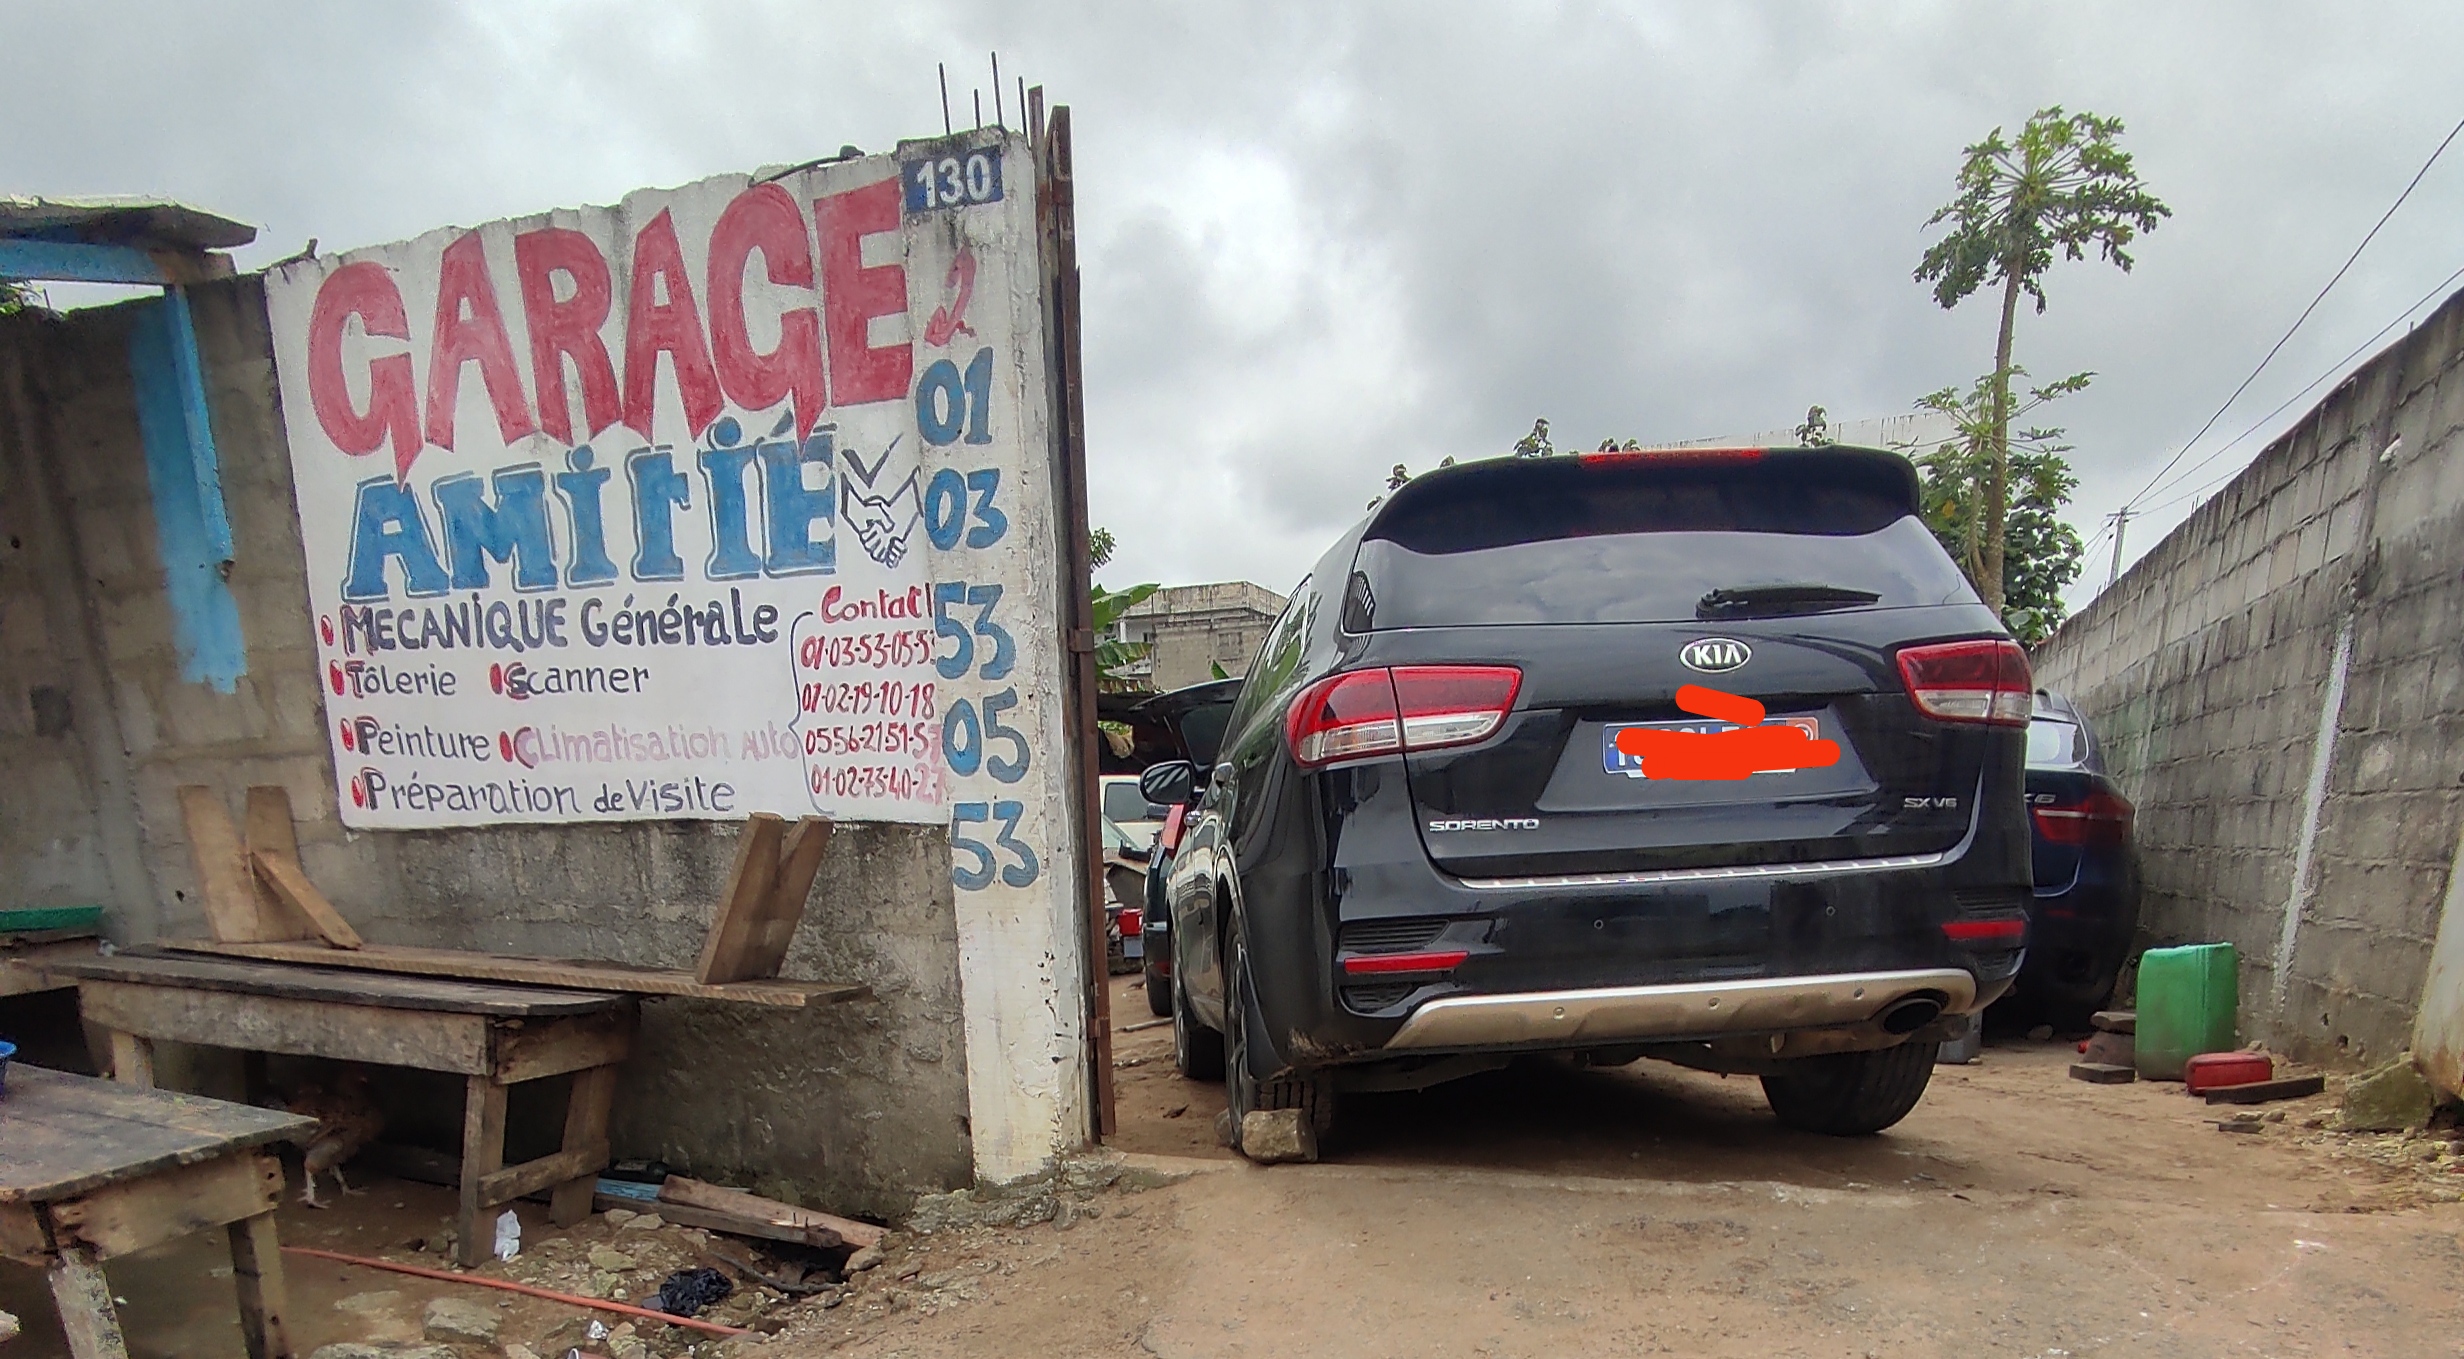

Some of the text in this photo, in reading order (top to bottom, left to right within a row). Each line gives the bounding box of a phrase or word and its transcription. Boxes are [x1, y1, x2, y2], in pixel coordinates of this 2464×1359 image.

[917, 153, 991, 208] 130
[308, 176, 914, 492] GARAGE
[916, 346, 993, 446] 01
[925, 467, 1008, 551] 03
[933, 581, 1017, 680] 53
[345, 660, 649, 700] Tôlerie Scanner
[355, 716, 490, 762] Peinture
[942, 686, 1031, 784] 05
[360, 766, 735, 815] Préparation de Visite
[1429, 818, 1540, 832] SORENTO
[1904, 797, 1958, 808] SX V6
[951, 801, 1039, 891] 53
